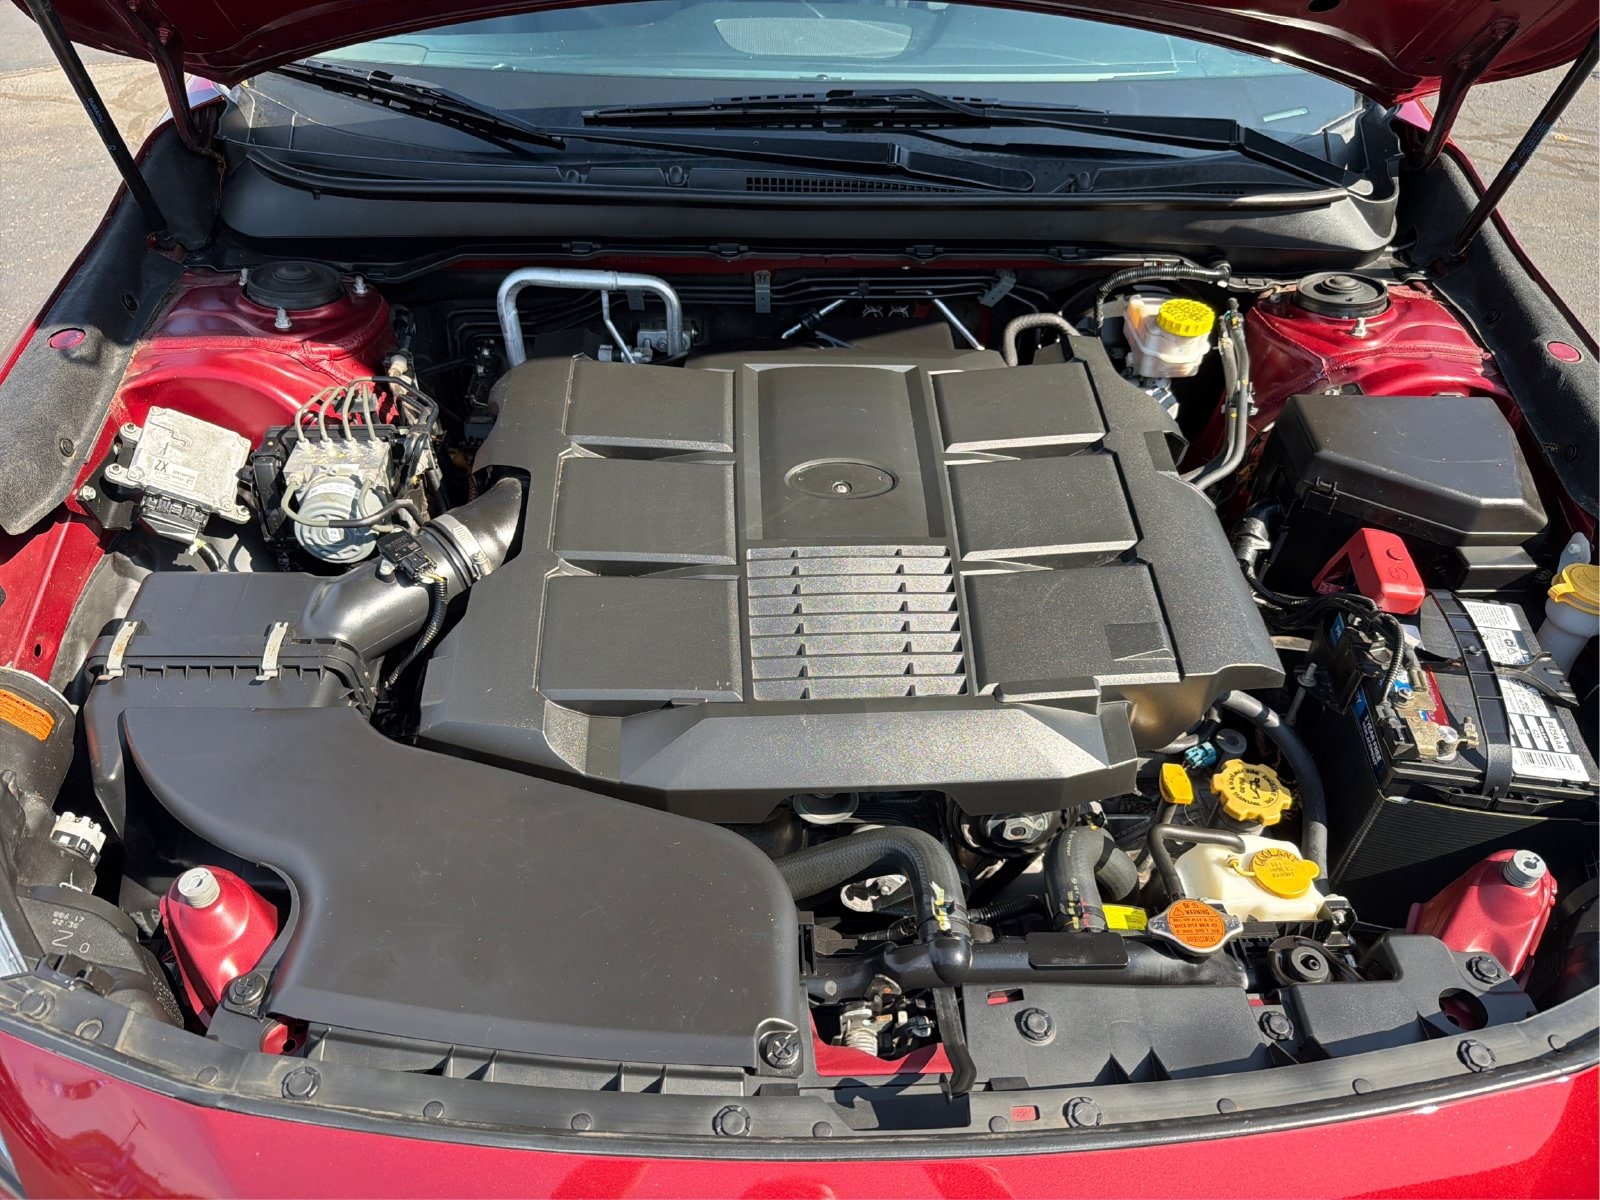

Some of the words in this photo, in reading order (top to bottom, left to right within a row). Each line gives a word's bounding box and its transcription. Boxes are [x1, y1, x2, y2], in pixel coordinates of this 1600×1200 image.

[154, 459, 169, 473] ZX
[1254, 849, 1298, 866] COOLANT
[1184, 908, 1210, 916] WARNING
